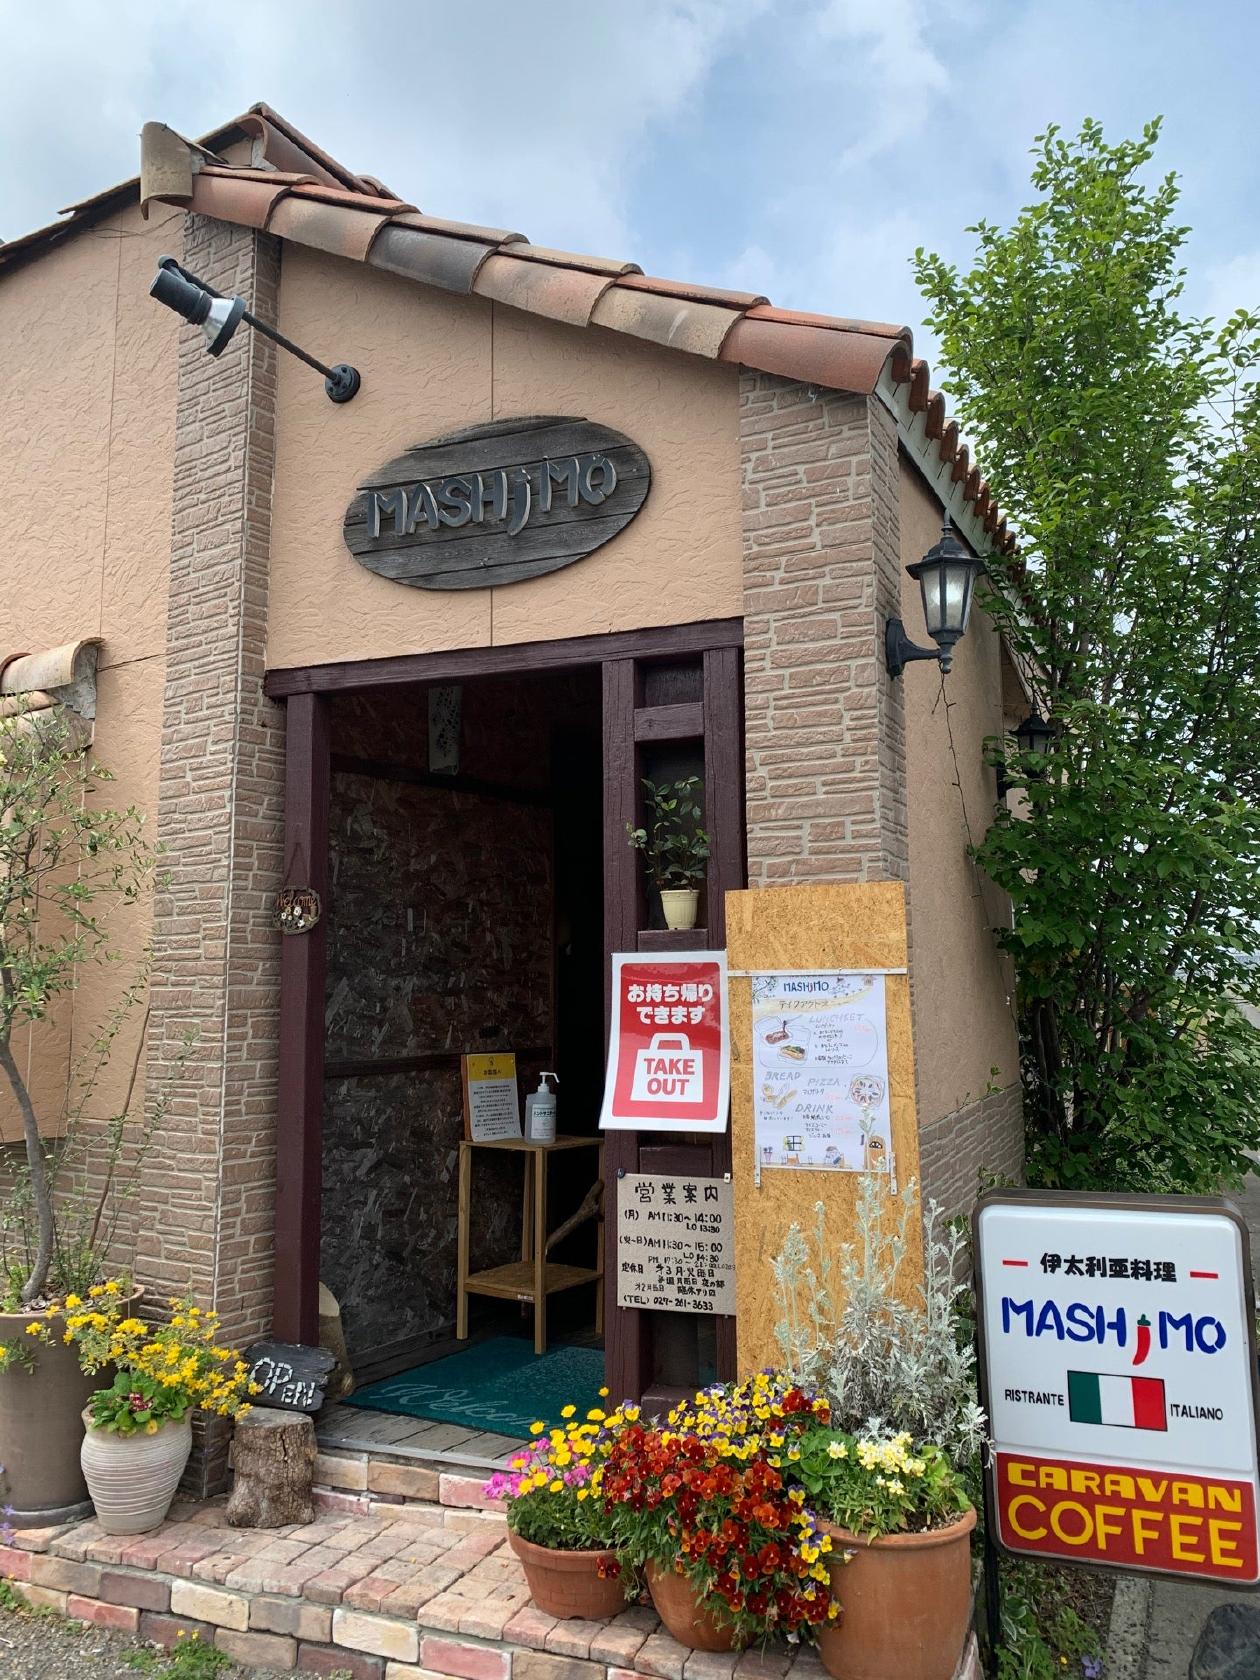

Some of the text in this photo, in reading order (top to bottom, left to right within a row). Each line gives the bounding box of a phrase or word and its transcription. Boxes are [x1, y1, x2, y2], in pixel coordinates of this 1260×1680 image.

[627, 983, 714, 1003] お持ち帰り
[636, 1005, 706, 1025] できます
[643, 1058, 696, 1075] TAKE
[764, 1071, 801, 1081] BREAD
[646, 1078, 690, 1096] OUT
[807, 1078, 841, 1087] PIZZA
[795, 1103, 834, 1114] DRINK
[634, 1182, 719, 1205] 営業案内
[621, 1261, 644, 1274] 定休日
[1039, 1252, 1178, 1283] 伊太利亜料理
[653, 1296, 714, 1311] 027-261-3633
[1004, 1388, 1224, 1421] RISTRANTE ITALIANO
[1007, 1462, 1243, 1513] CARAVAN
[1008, 1494, 1244, 1567] COFFEE
